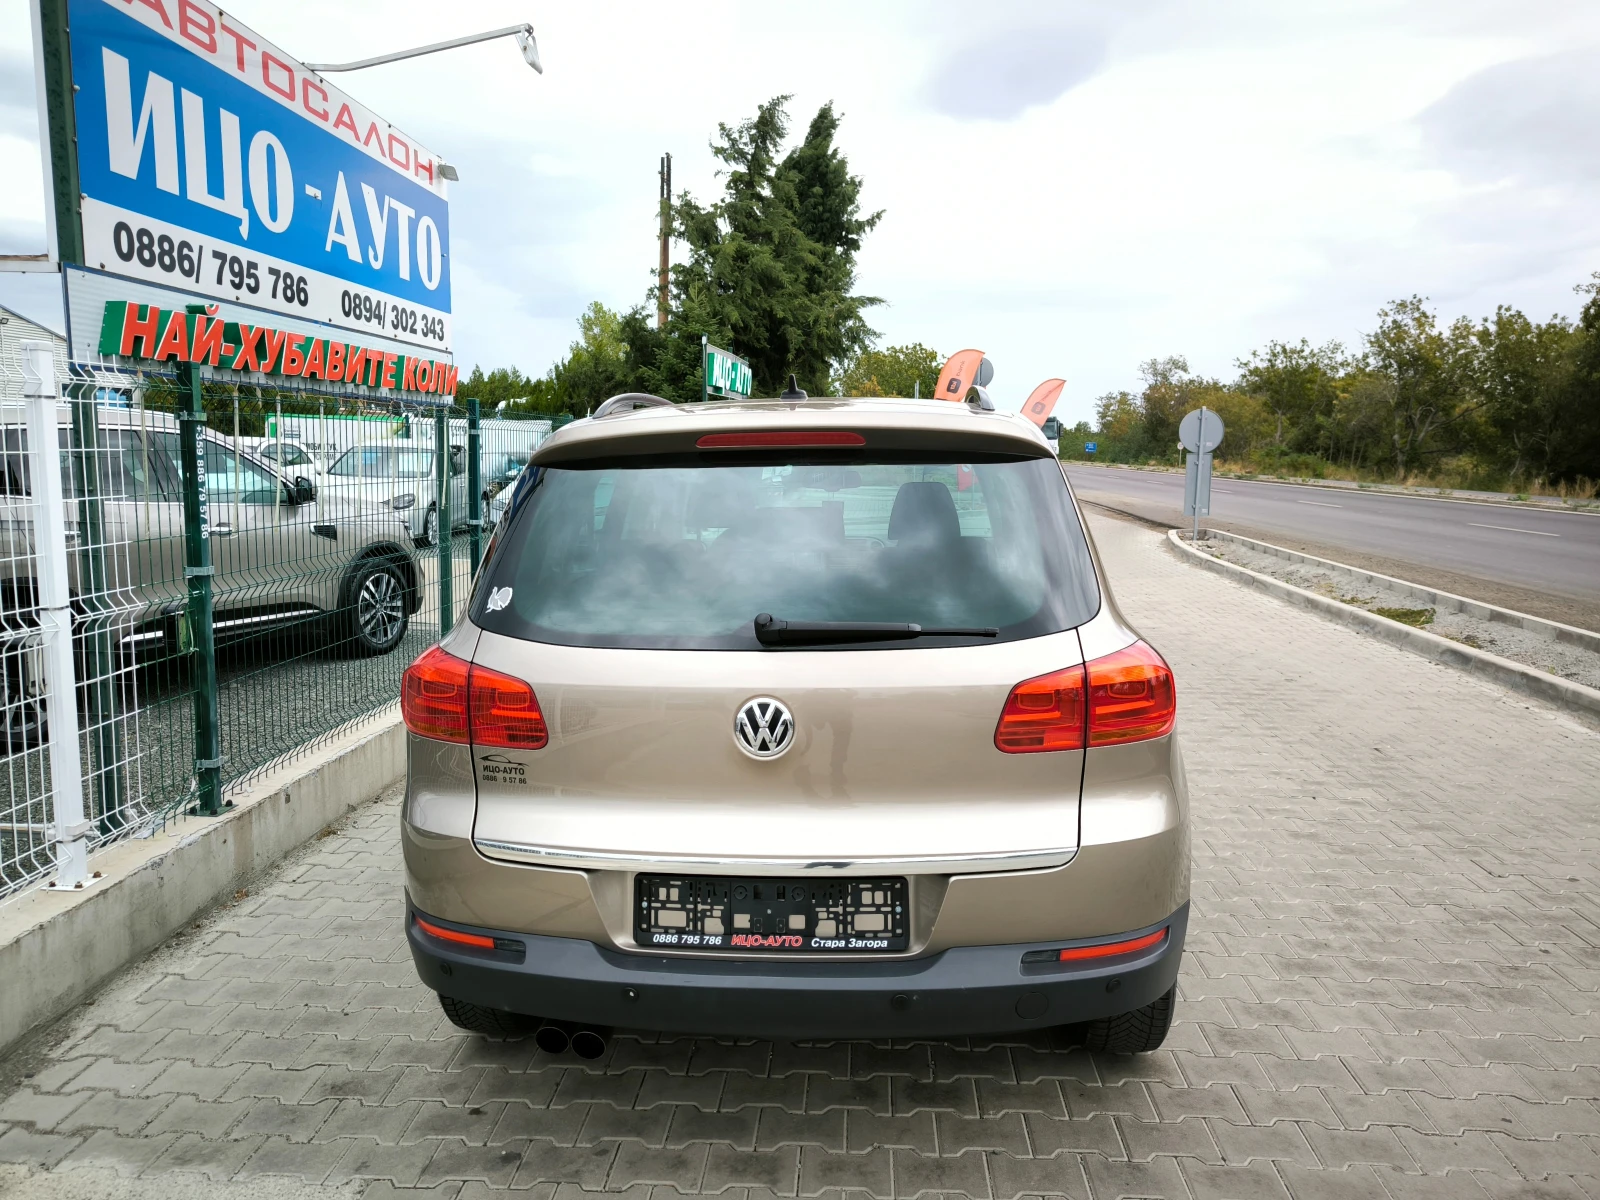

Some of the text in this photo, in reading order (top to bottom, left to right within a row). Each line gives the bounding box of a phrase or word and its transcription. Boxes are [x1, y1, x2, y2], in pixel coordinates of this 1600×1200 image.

[102, 46, 442, 291] ИЦО-АУТО
[113, 221, 445, 341] 0886/ 795 786 0894/ 302 343
[119, 300, 459, 396] НАЙ-ХУБАВИТЕ КОЛИ
[196, 460, 205, 482] 886
[199, 485, 206, 501] 79
[200, 505, 208, 519] 57
[201, 523, 209, 539] 86
[483, 764, 525, 775] ИЦО-АУТО
[653, 933, 888, 949] 0886 795 786 ИЦО-АУТО Стара Загора
